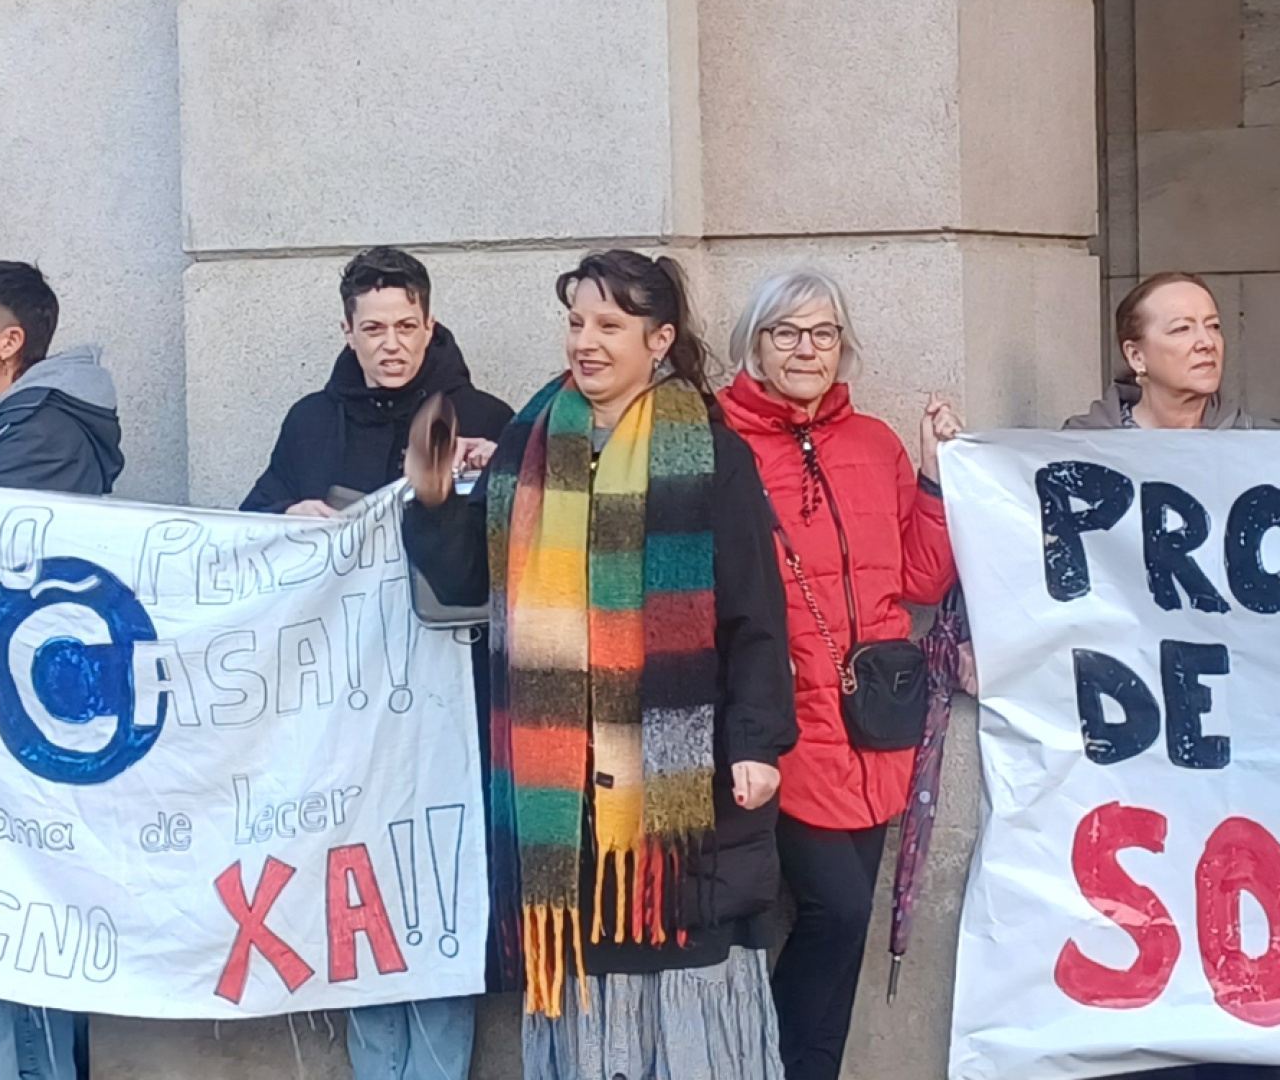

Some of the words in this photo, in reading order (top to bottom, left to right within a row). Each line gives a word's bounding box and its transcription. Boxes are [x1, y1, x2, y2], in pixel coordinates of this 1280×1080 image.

[1073, 640, 1231, 770] DE
[139, 811, 193, 853] de
[213, 803, 465, 1006] XA!!
